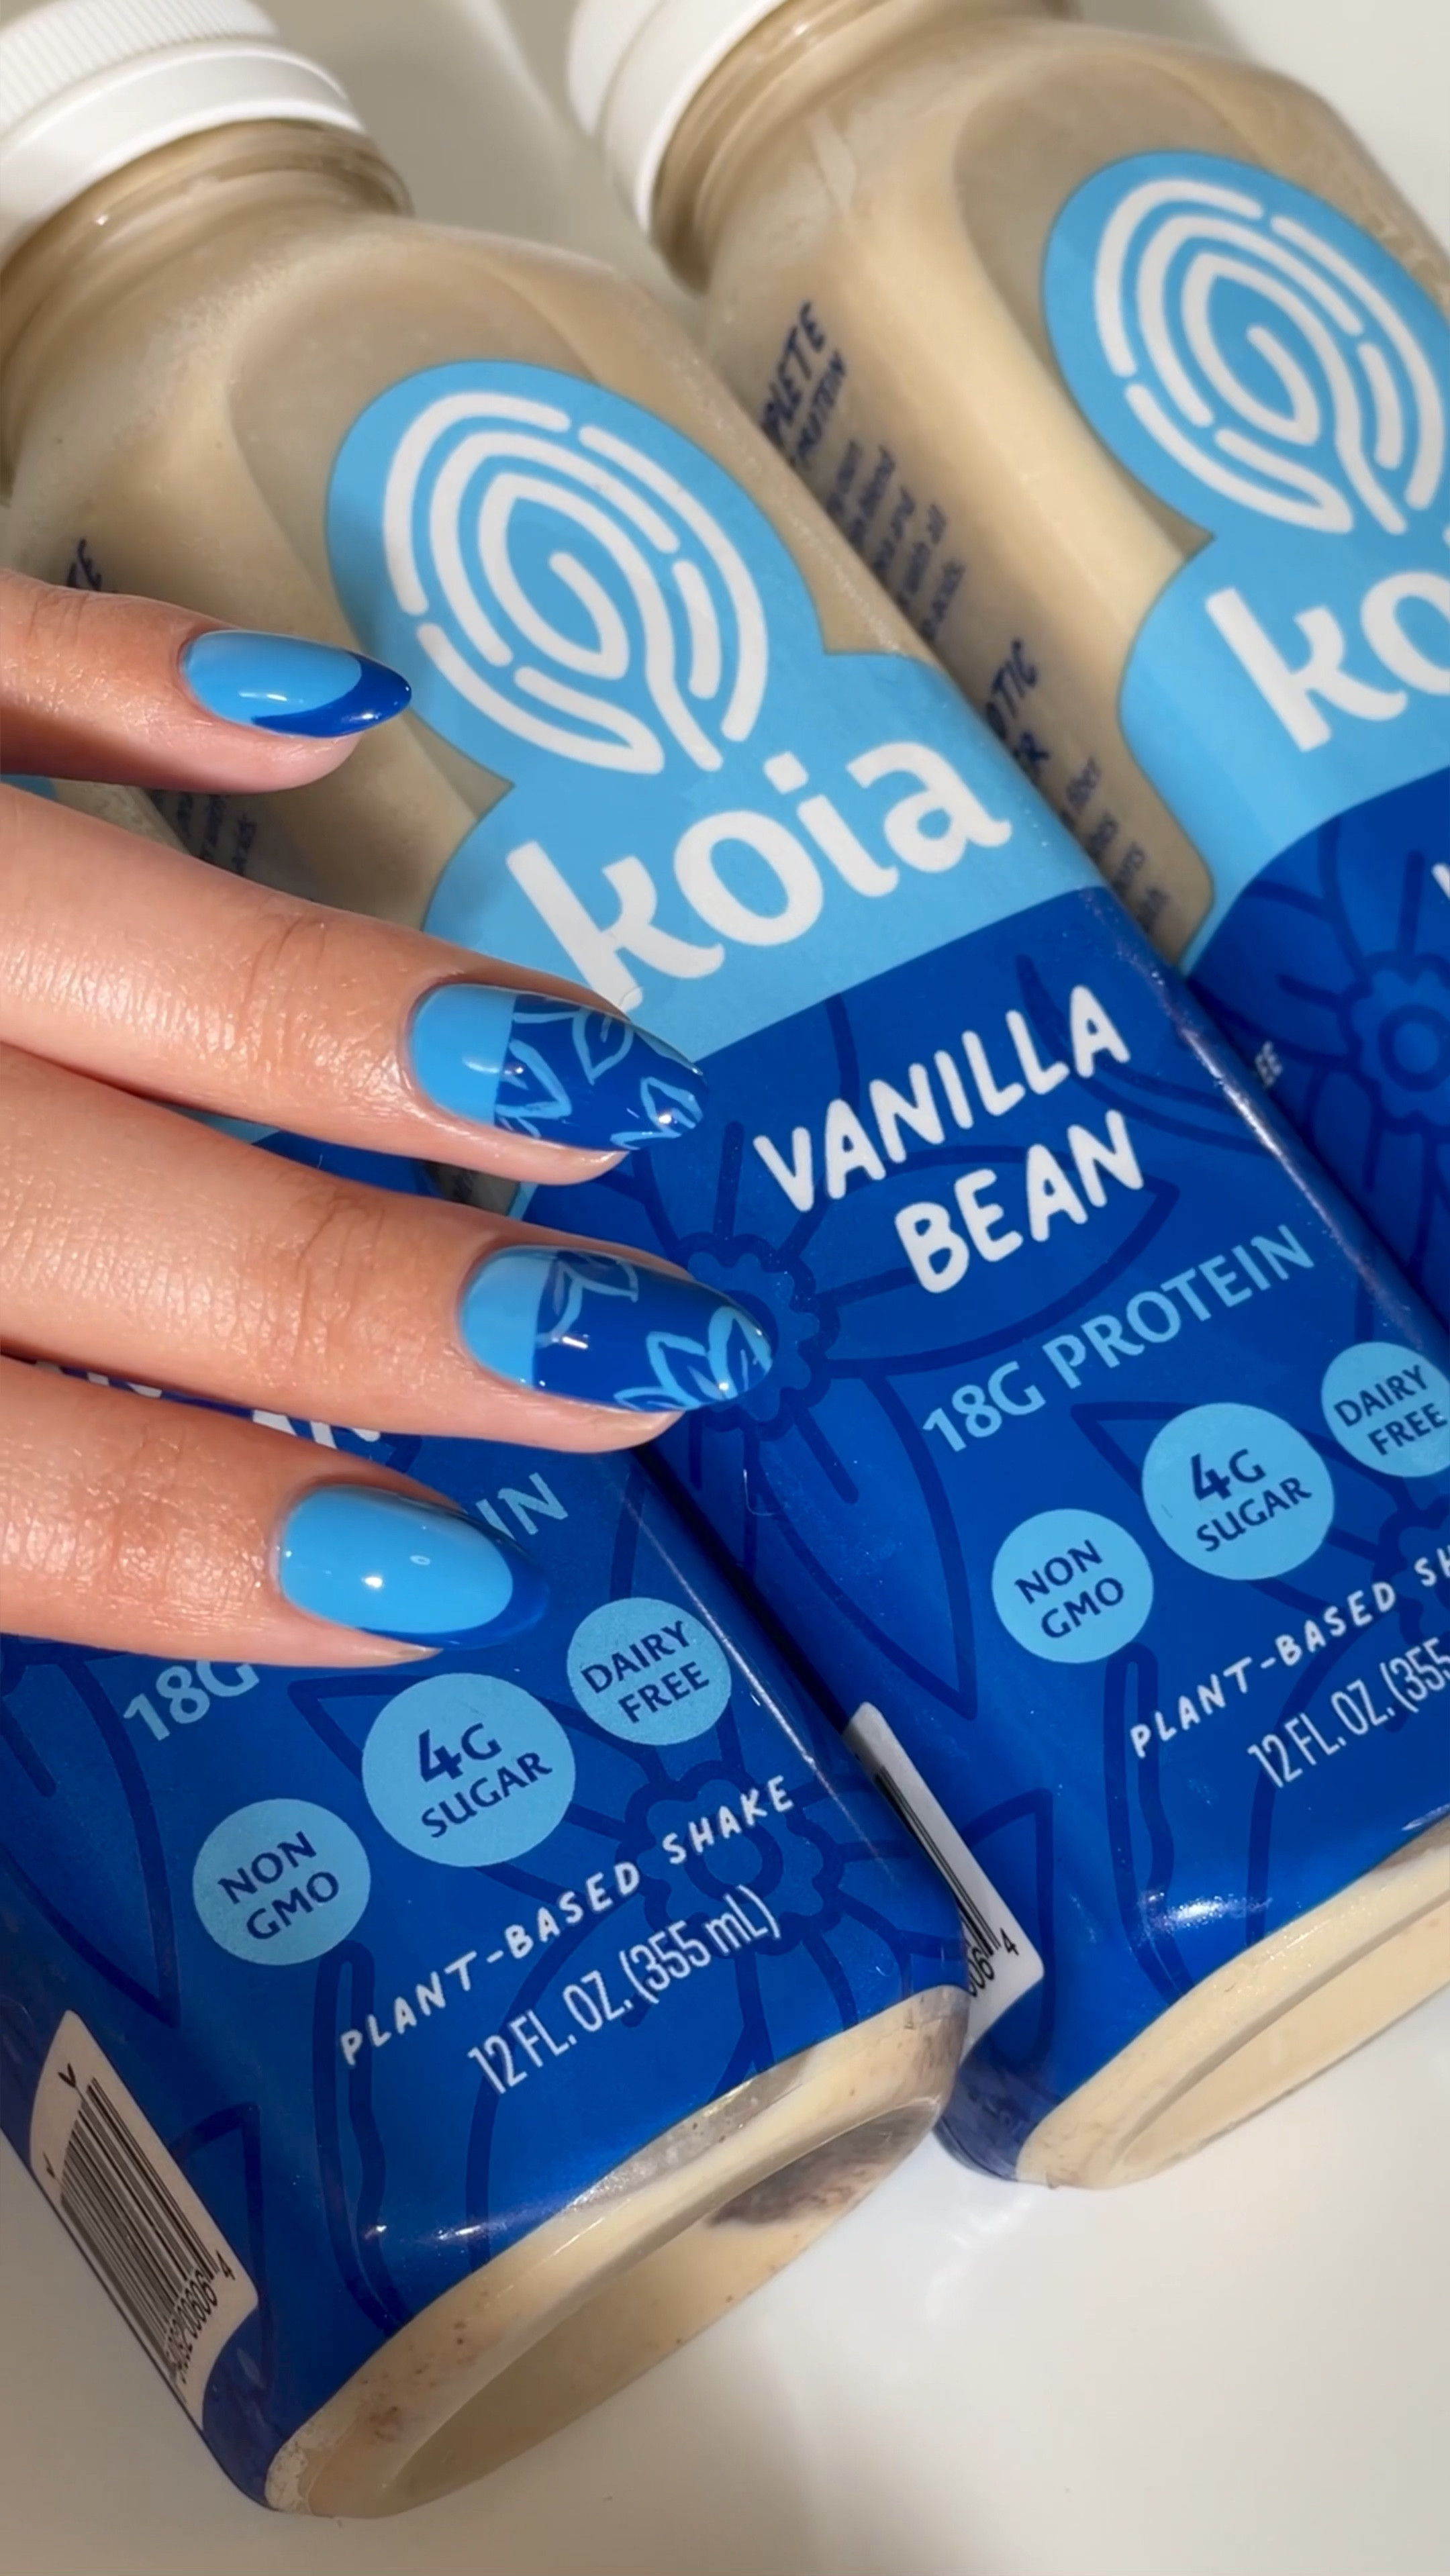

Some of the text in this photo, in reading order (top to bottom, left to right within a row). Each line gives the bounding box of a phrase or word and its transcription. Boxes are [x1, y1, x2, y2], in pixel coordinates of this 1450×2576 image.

[505, 741, 1012, 1013] koia
[753, 985, 1131, 1211] VANILLA
[894, 1109, 1144, 1293] BEAN
[922, 1224, 1314, 1452] 18G PROTEIN
[1333, 1364, 1428, 1427] DAIRY
[1367, 1402, 1448, 1456] FREE
[1189, 1448, 1267, 1503] 4G
[1195, 1477, 1312, 1552] SUGAR
[1014, 1539, 1104, 1605] NON
[1040, 1576, 1125, 1639] GMO
[580, 1620, 691, 1695] DAIRY
[616, 1661, 711, 1724] FREE
[1130, 1581, 1396, 1758] PLANT-BASED
[416, 1722, 503, 1785] 4G
[420, 1750, 554, 1840] SUGAR
[216, 1830, 318, 1905] NON
[245, 1871, 340, 1942] GMO
[340, 1775, 795, 2068] PLANT-BASED SHAKE
[1000, 1927, 1020, 1957] 4
[468, 2032, 528, 2095] 12
[619, 1920, 713, 2006] (355
[705, 1884, 781, 1956] mL)
[215, 2249, 236, 2281] 4
